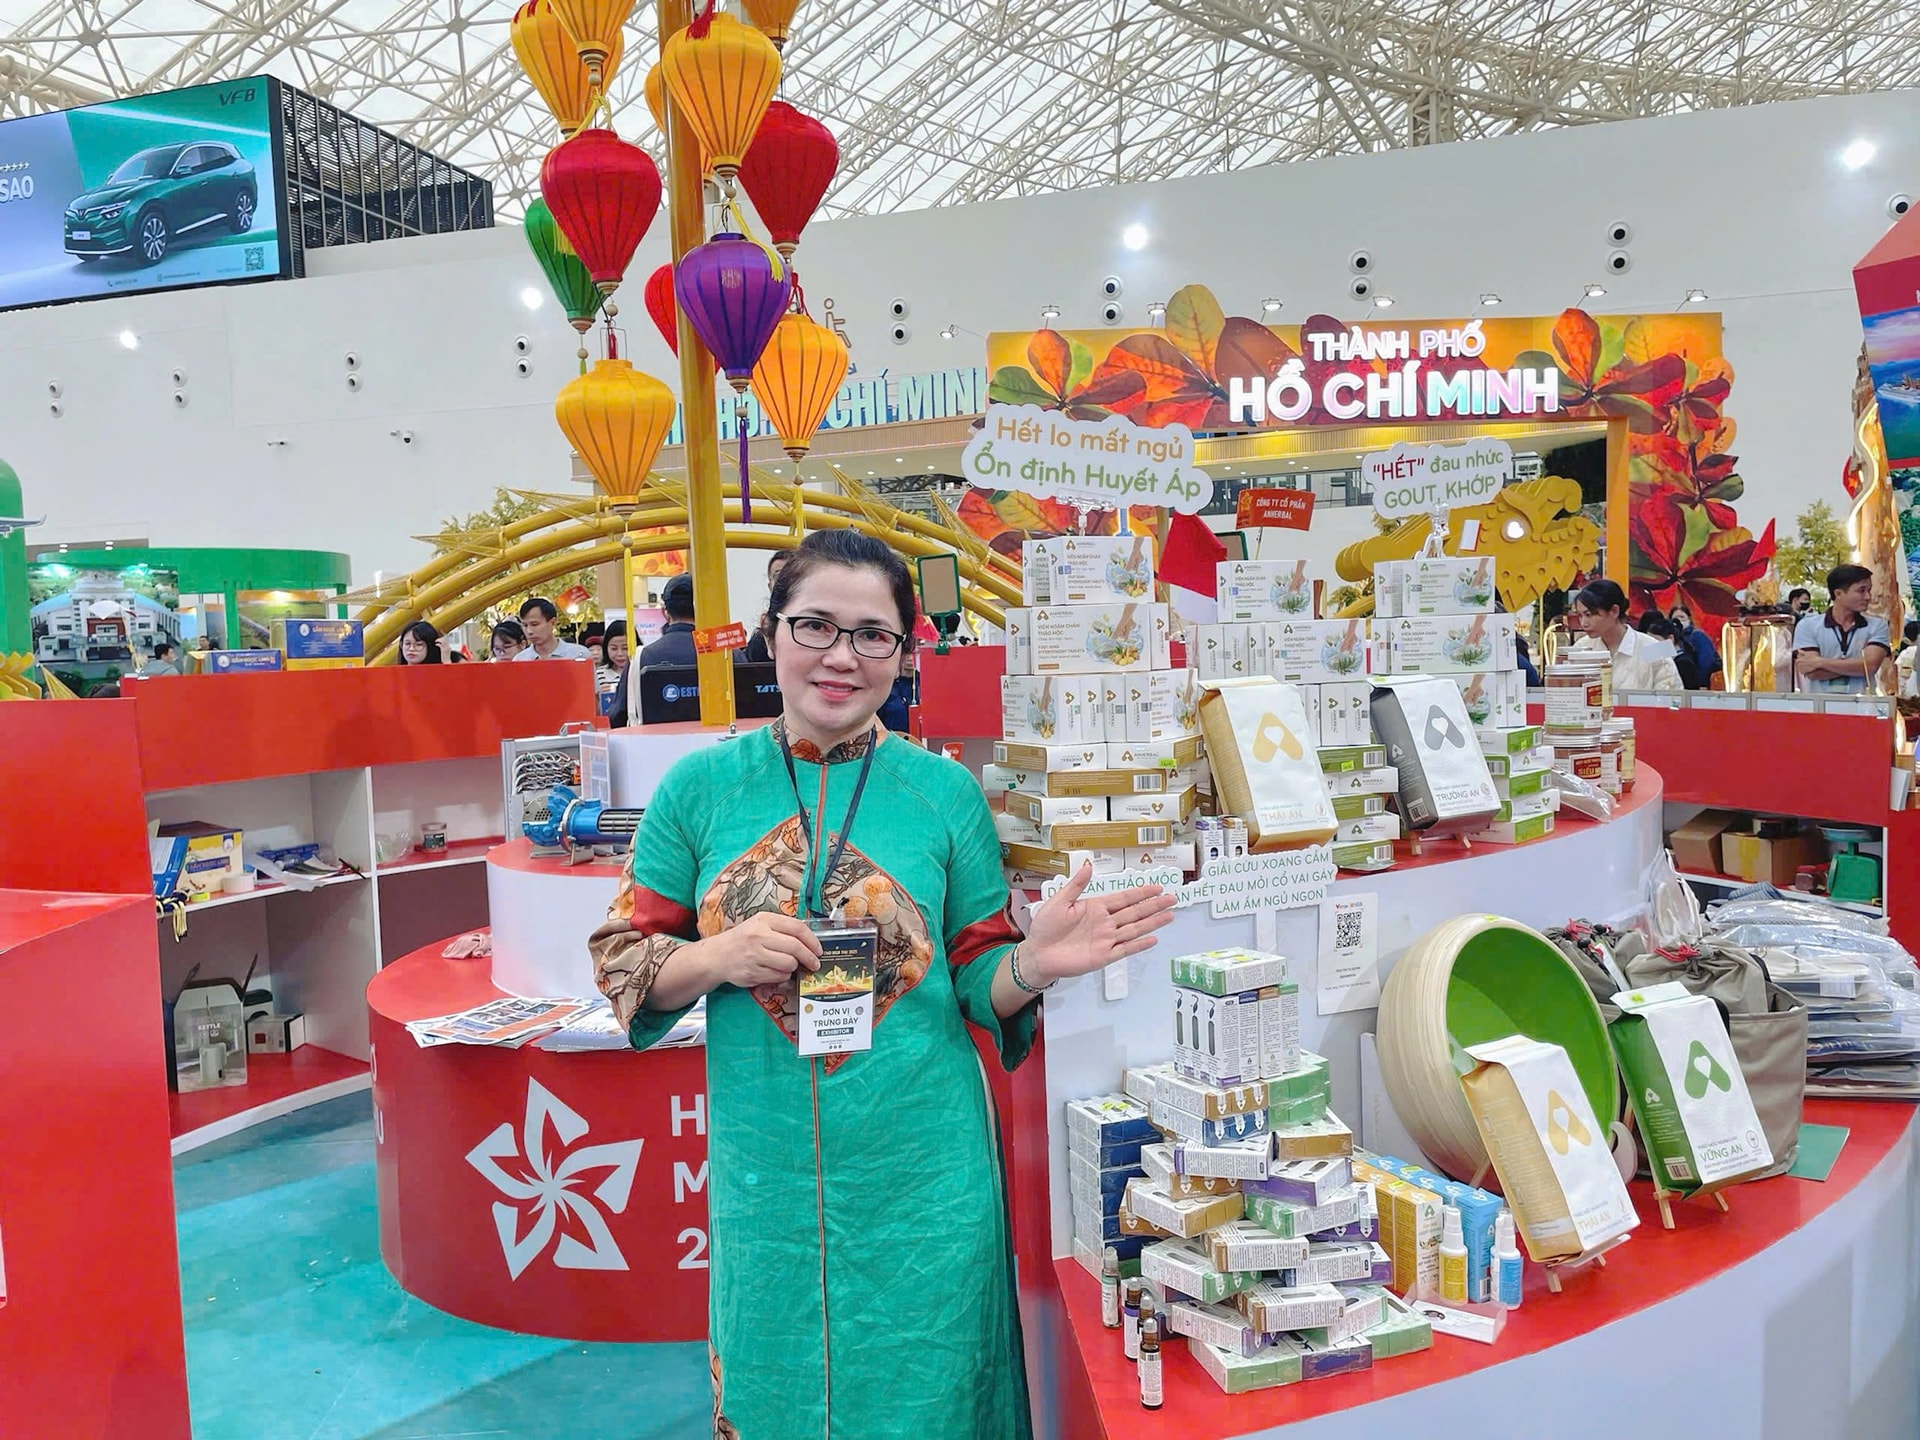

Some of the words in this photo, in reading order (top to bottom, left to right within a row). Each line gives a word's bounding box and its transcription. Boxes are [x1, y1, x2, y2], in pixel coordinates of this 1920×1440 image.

[1307, 326, 1410, 362] THÀNH
[1419, 319, 1486, 358] PHỐ
[1229, 358, 1313, 423] HỒ
[1322, 360, 1421, 420] CHÍ
[1426, 366, 1559, 417] MINH
[997, 417, 1042, 445] Hết
[1050, 423, 1071, 447] lo
[1080, 425, 1129, 453] mất
[1137, 436, 1183, 462] ngủ
[974, 441, 1011, 477] Ổn
[1020, 457, 1075, 487] định
[1086, 464, 1158, 496] Huyết
[1165, 468, 1201, 502] Áp
[1430, 456, 1460, 474] đau
[1465, 449, 1504, 470] nhức
[1446, 475, 1496, 499] KHỚP
[1208, 860, 1231, 877] GIẢI
[1234, 857, 1259, 875] CỨU
[1262, 854, 1301, 871] XOANG
[1304, 849, 1329, 866] CẢM
[1109, 875, 1146, 892] THẢO
[1149, 871, 1179, 888] MỘC
[1193, 880, 1216, 898] HẾT
[1219, 880, 1244, 894] ĐAU
[1247, 875, 1269, 891] MỎI
[1272, 870, 1288, 889] CỔ
[1291, 870, 1309, 884] VAI
[1312, 867, 1335, 882] GÁY
[1215, 898, 1241, 914] LÀM
[1264, 891, 1290, 907] NGỦ
[1292, 888, 1324, 904] NGON
[813, 1018, 841, 1028] TRƯNG
[843, 1016, 859, 1026] BÀY
[823, 1008, 840, 1016] ĐƠN
[1730, 1143, 1743, 1155] AN
